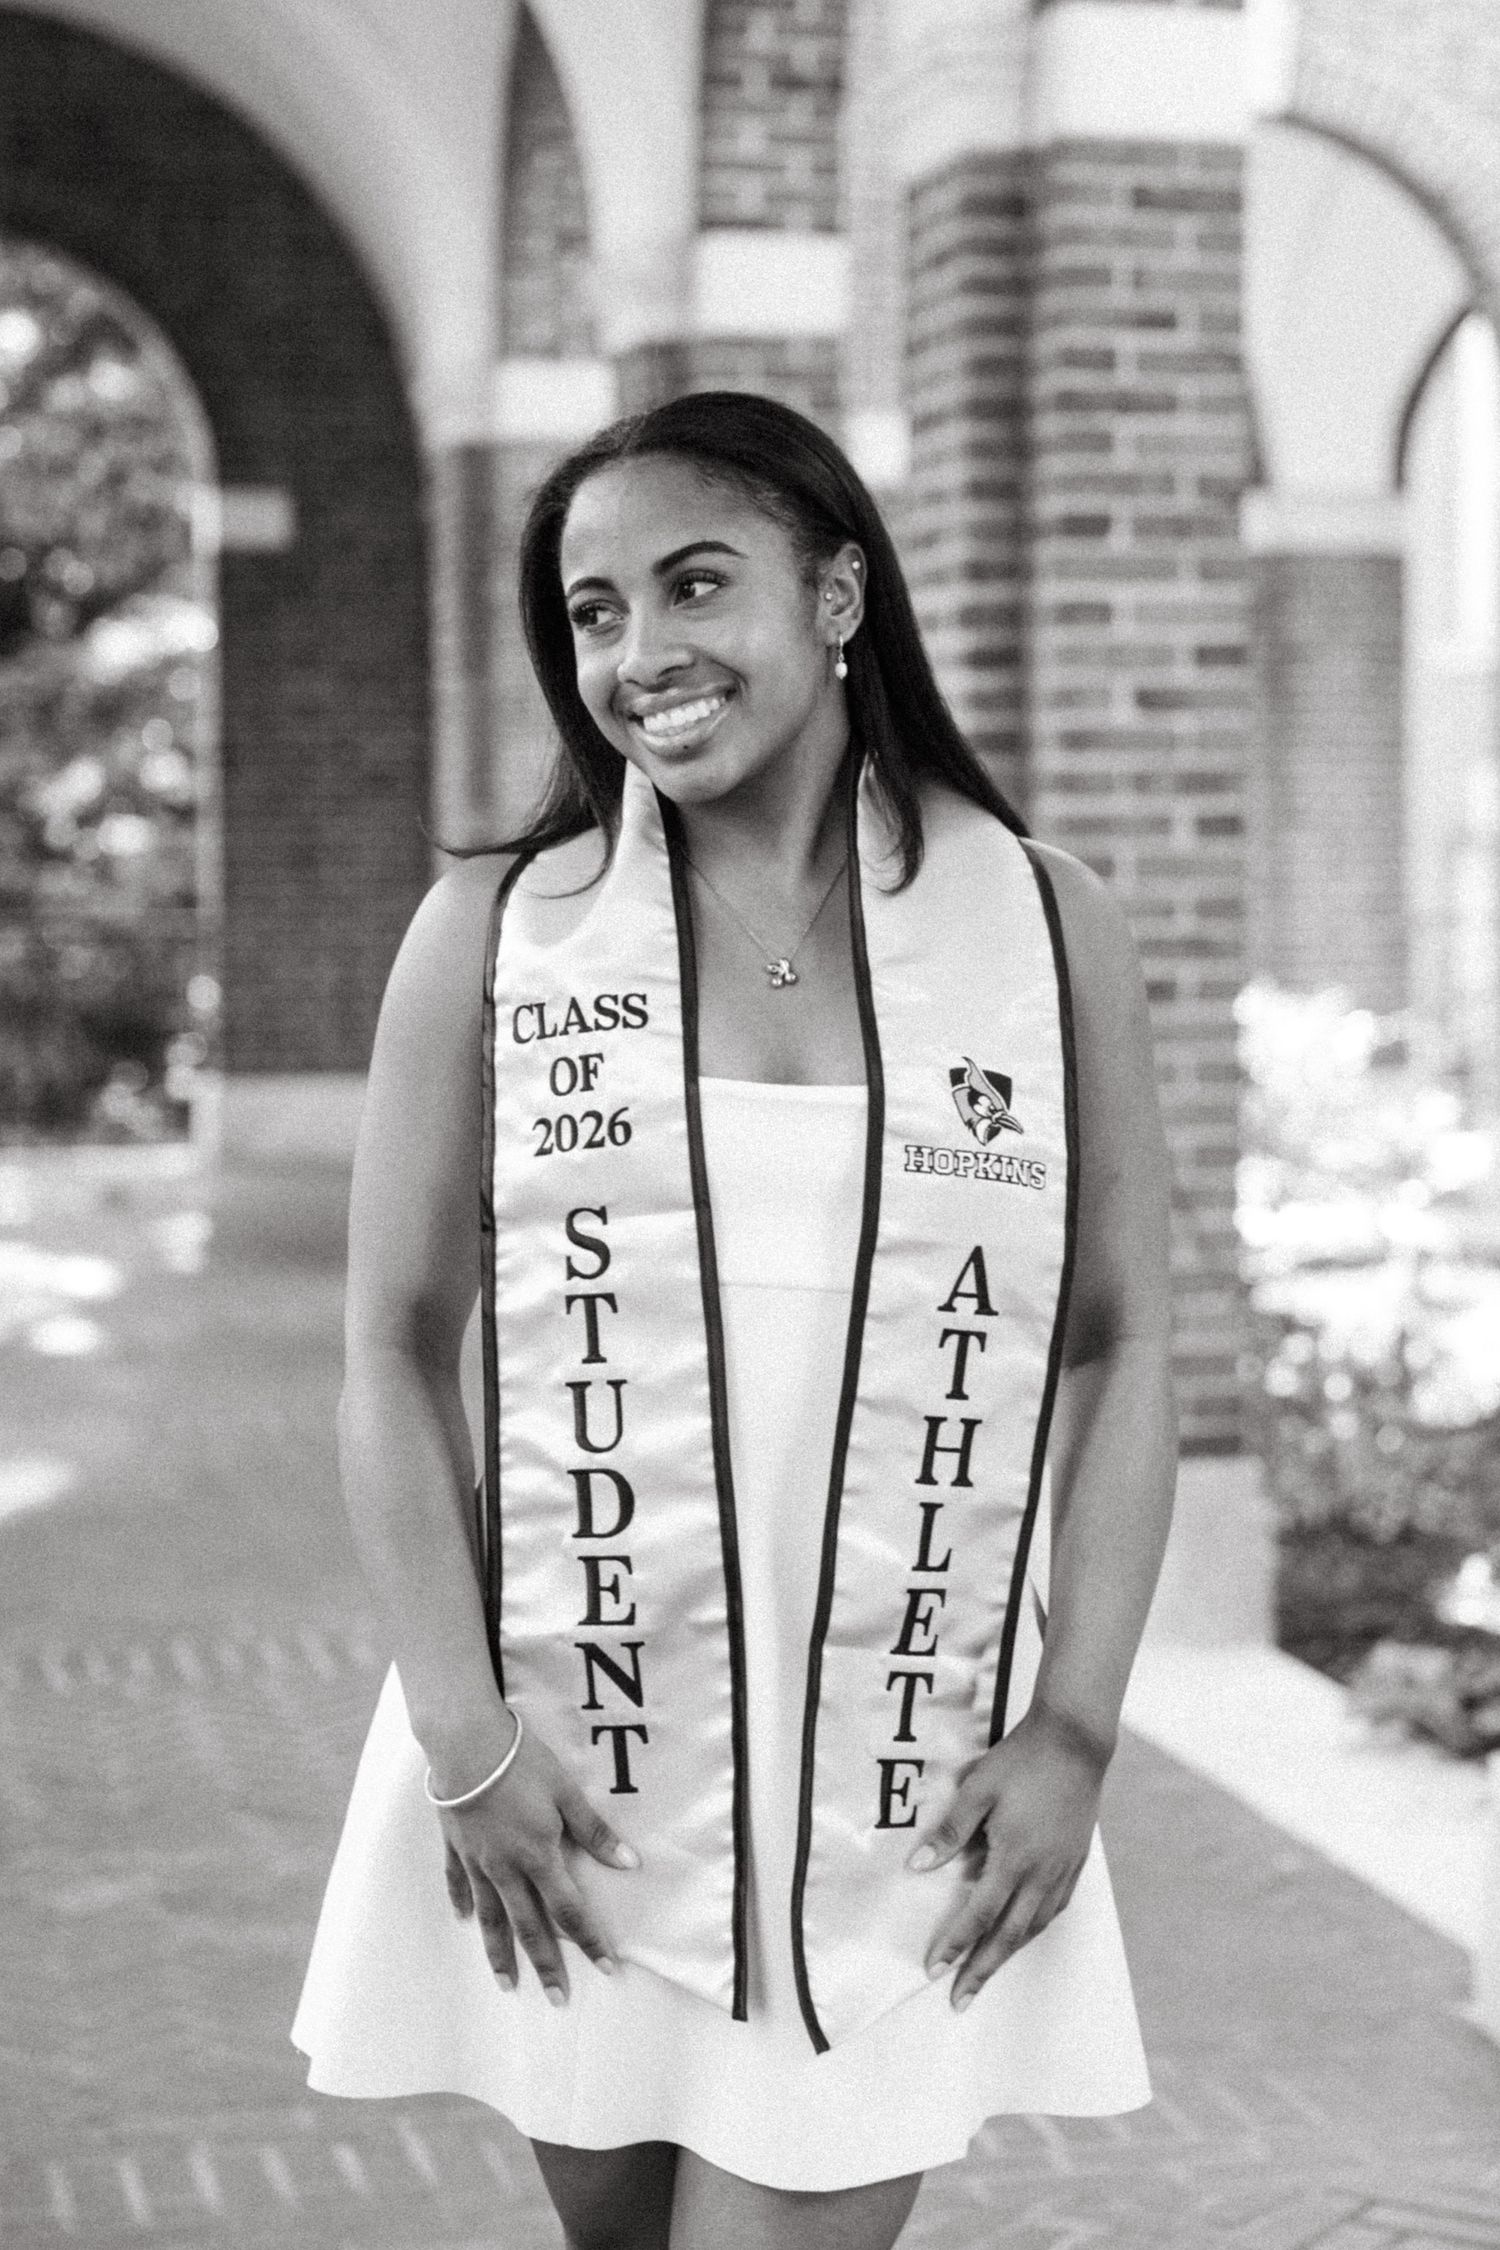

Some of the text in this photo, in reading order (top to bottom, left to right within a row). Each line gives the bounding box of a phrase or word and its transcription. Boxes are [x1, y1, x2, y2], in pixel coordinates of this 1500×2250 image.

[512, 993, 649, 1044] CLASS
[550, 1052, 605, 1096] OF
[532, 1106, 632, 1157] 2026
[904, 1144, 1047, 1190] HOPKINS
[565, 1205, 649, 1794] STUDENT
[874, 1245, 999, 1830] ATHLETE
